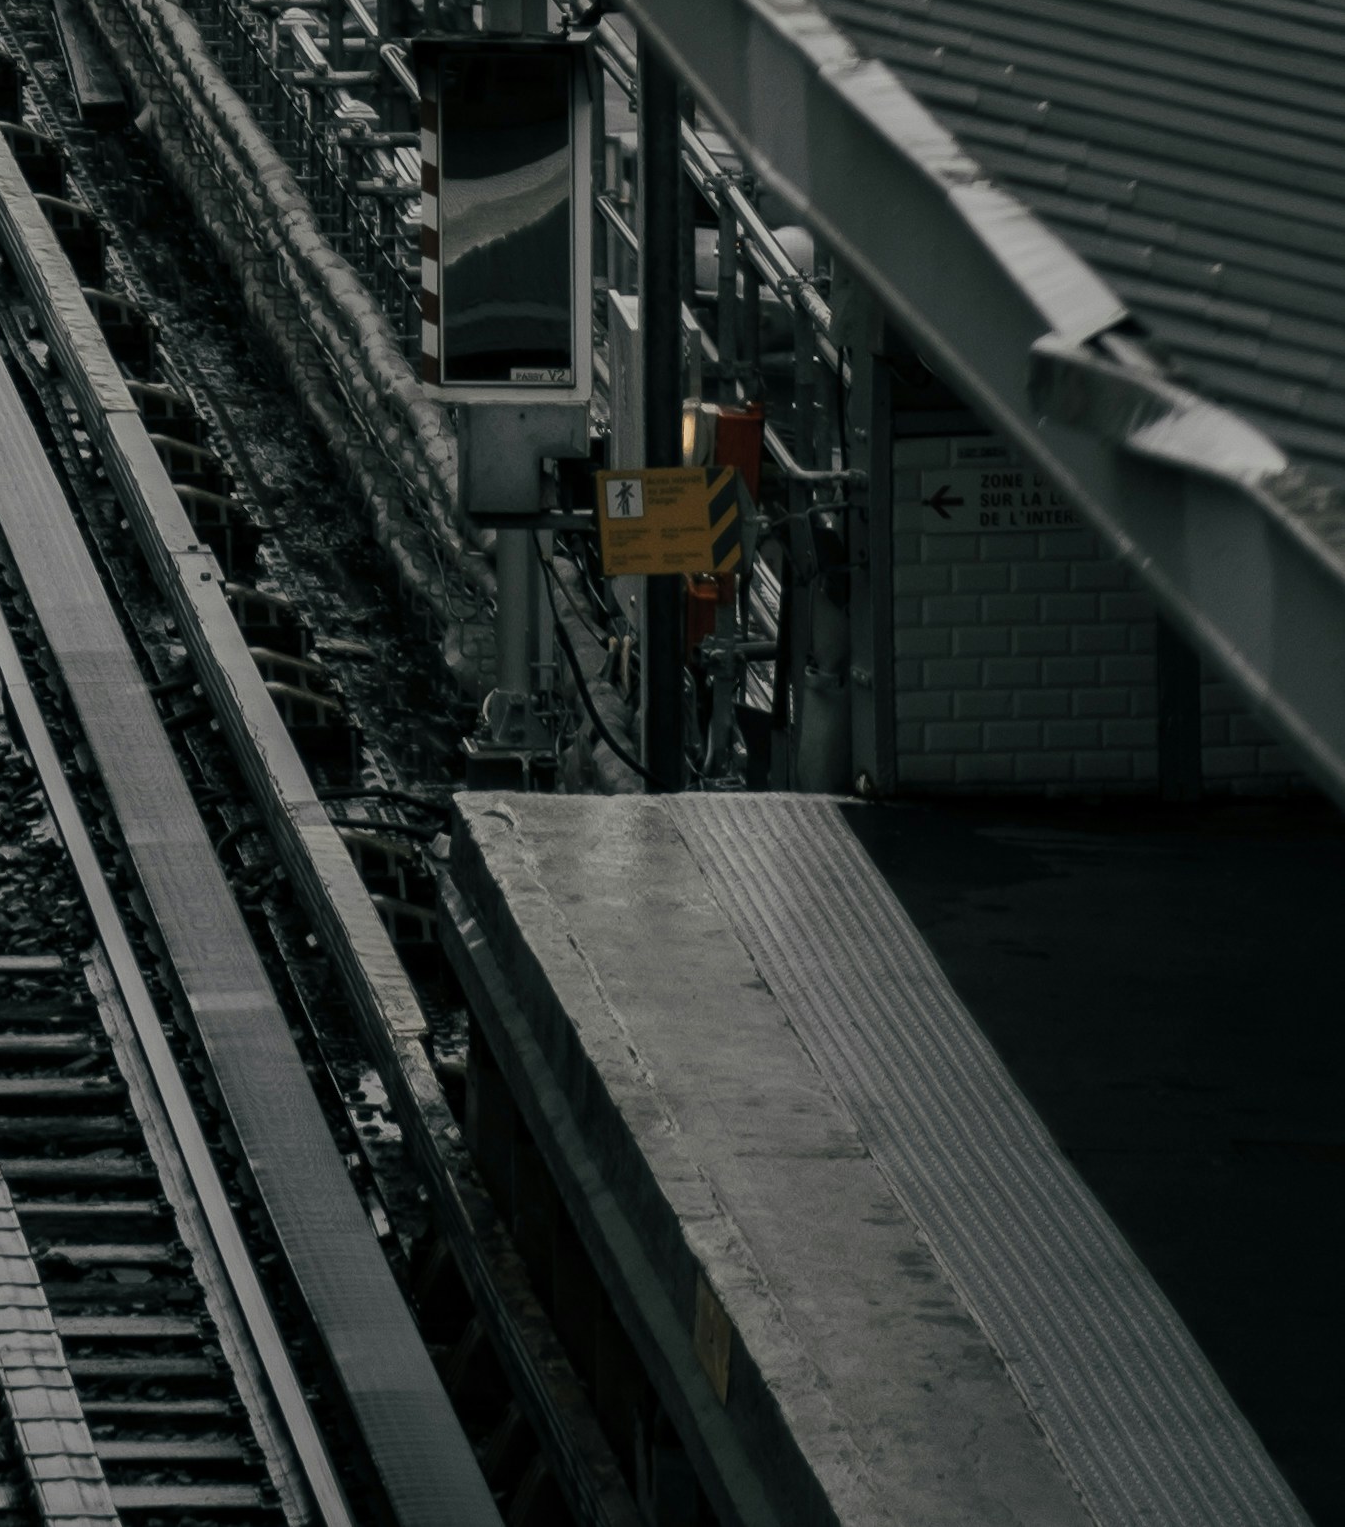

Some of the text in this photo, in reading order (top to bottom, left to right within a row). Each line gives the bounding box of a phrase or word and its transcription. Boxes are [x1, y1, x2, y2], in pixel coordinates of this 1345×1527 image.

[547, 369, 566, 382] V2
[980, 474, 1023, 489] ZONE
[980, 493, 1013, 508] SUR
[1021, 492, 1042, 507] LA
[980, 512, 1000, 527] DE
